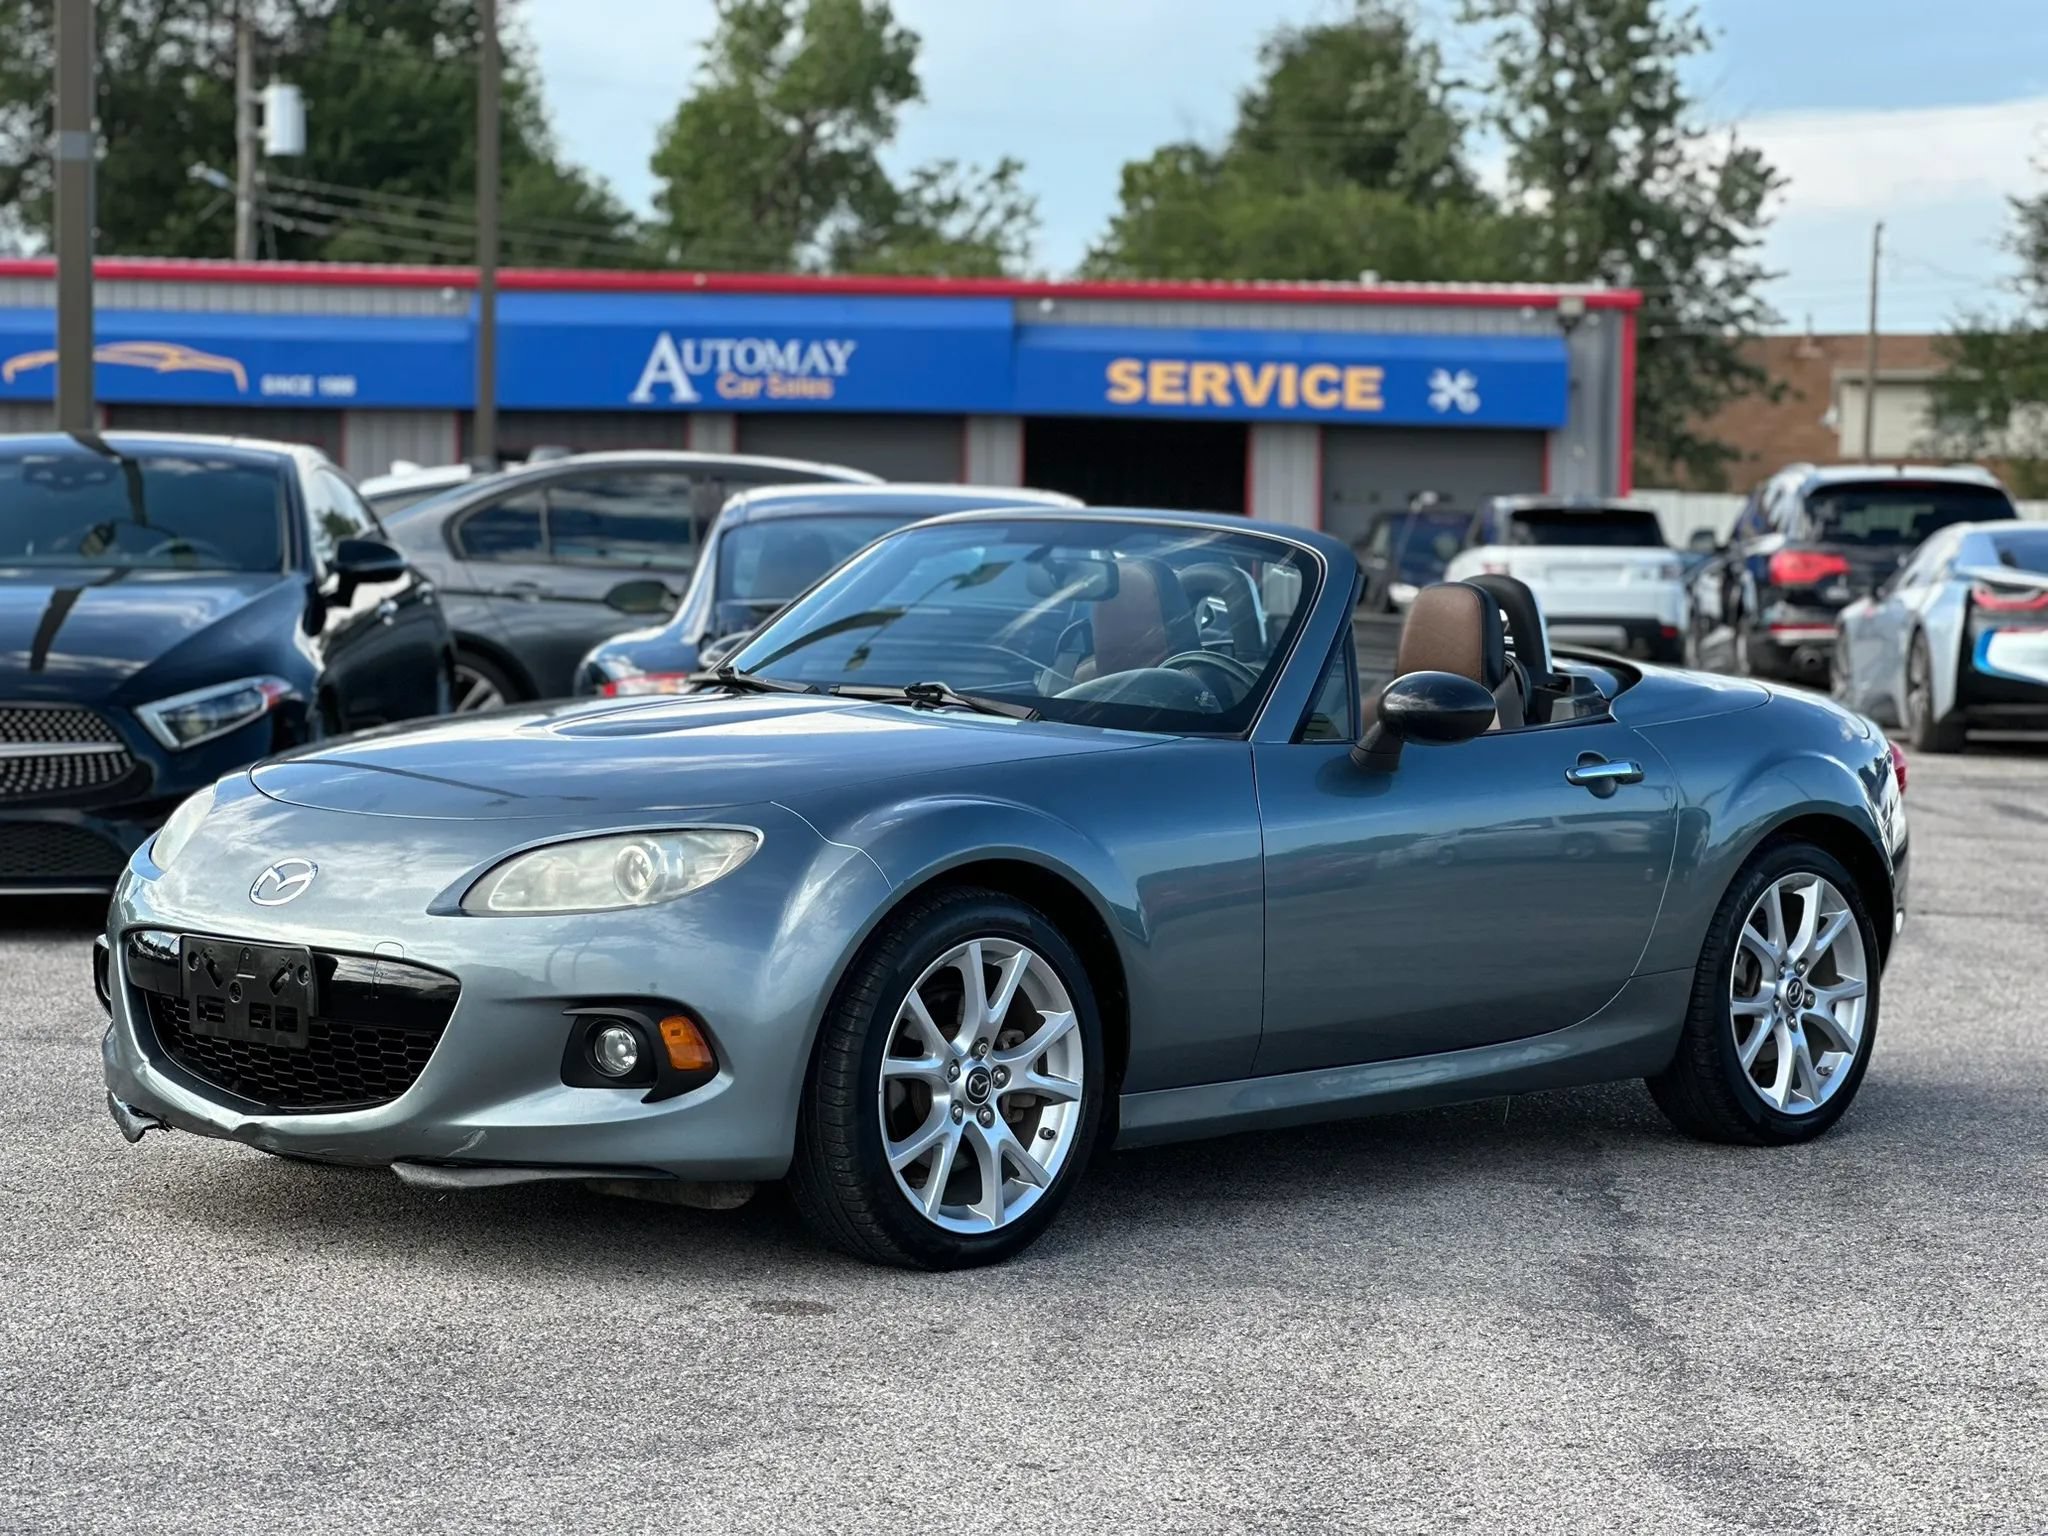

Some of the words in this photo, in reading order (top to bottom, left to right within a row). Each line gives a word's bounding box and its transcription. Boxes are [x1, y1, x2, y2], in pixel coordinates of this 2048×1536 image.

[717, 372, 762, 398] Car
[766, 373, 834, 398] Sales
[1106, 358, 1384, 410] SERVICE
